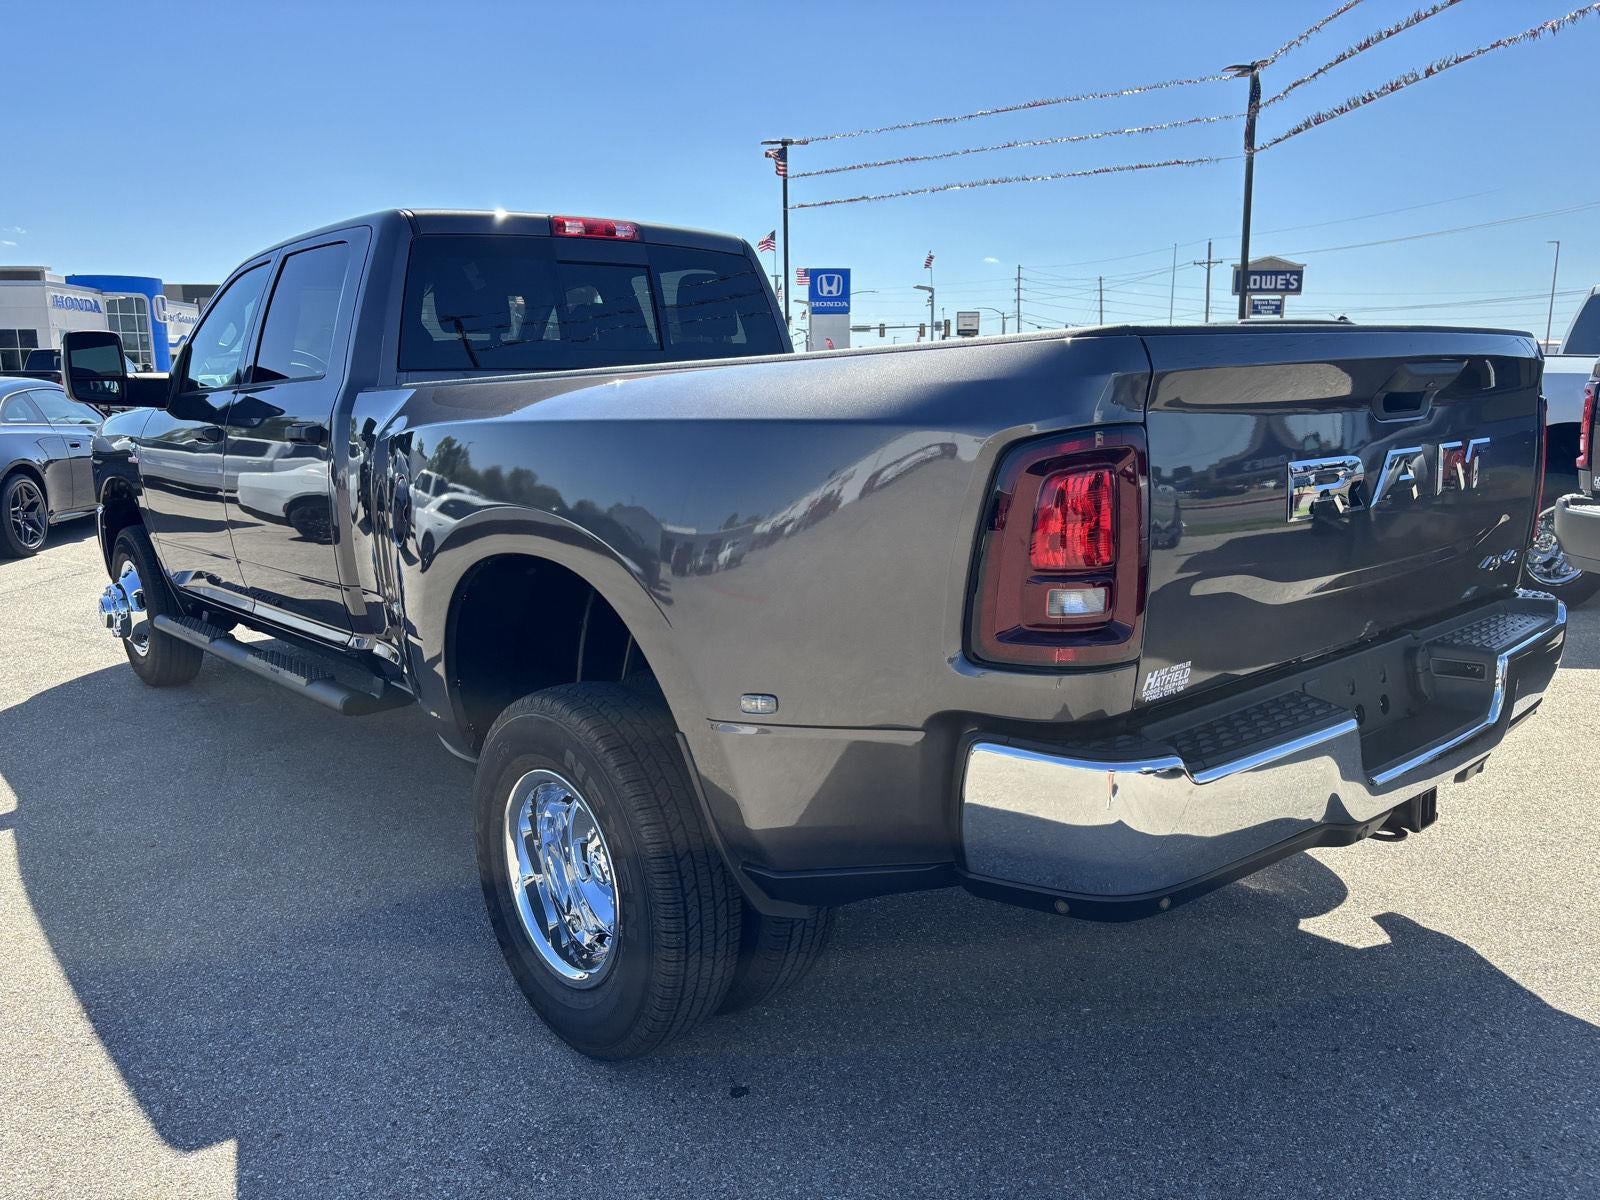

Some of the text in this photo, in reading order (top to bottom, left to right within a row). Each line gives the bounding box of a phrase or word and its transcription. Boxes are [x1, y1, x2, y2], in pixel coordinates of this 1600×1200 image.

[1246, 274, 1298, 289] OWE'S
[53, 295, 103, 313] HONDA
[1287, 437, 1491, 523] RAM
[1158, 661, 1191, 677] JAY CHRYSLER
[1142, 667, 1191, 692] HATFIELD
[1144, 690, 1163, 702] PONCA
[1176, 684, 1185, 692] OK
